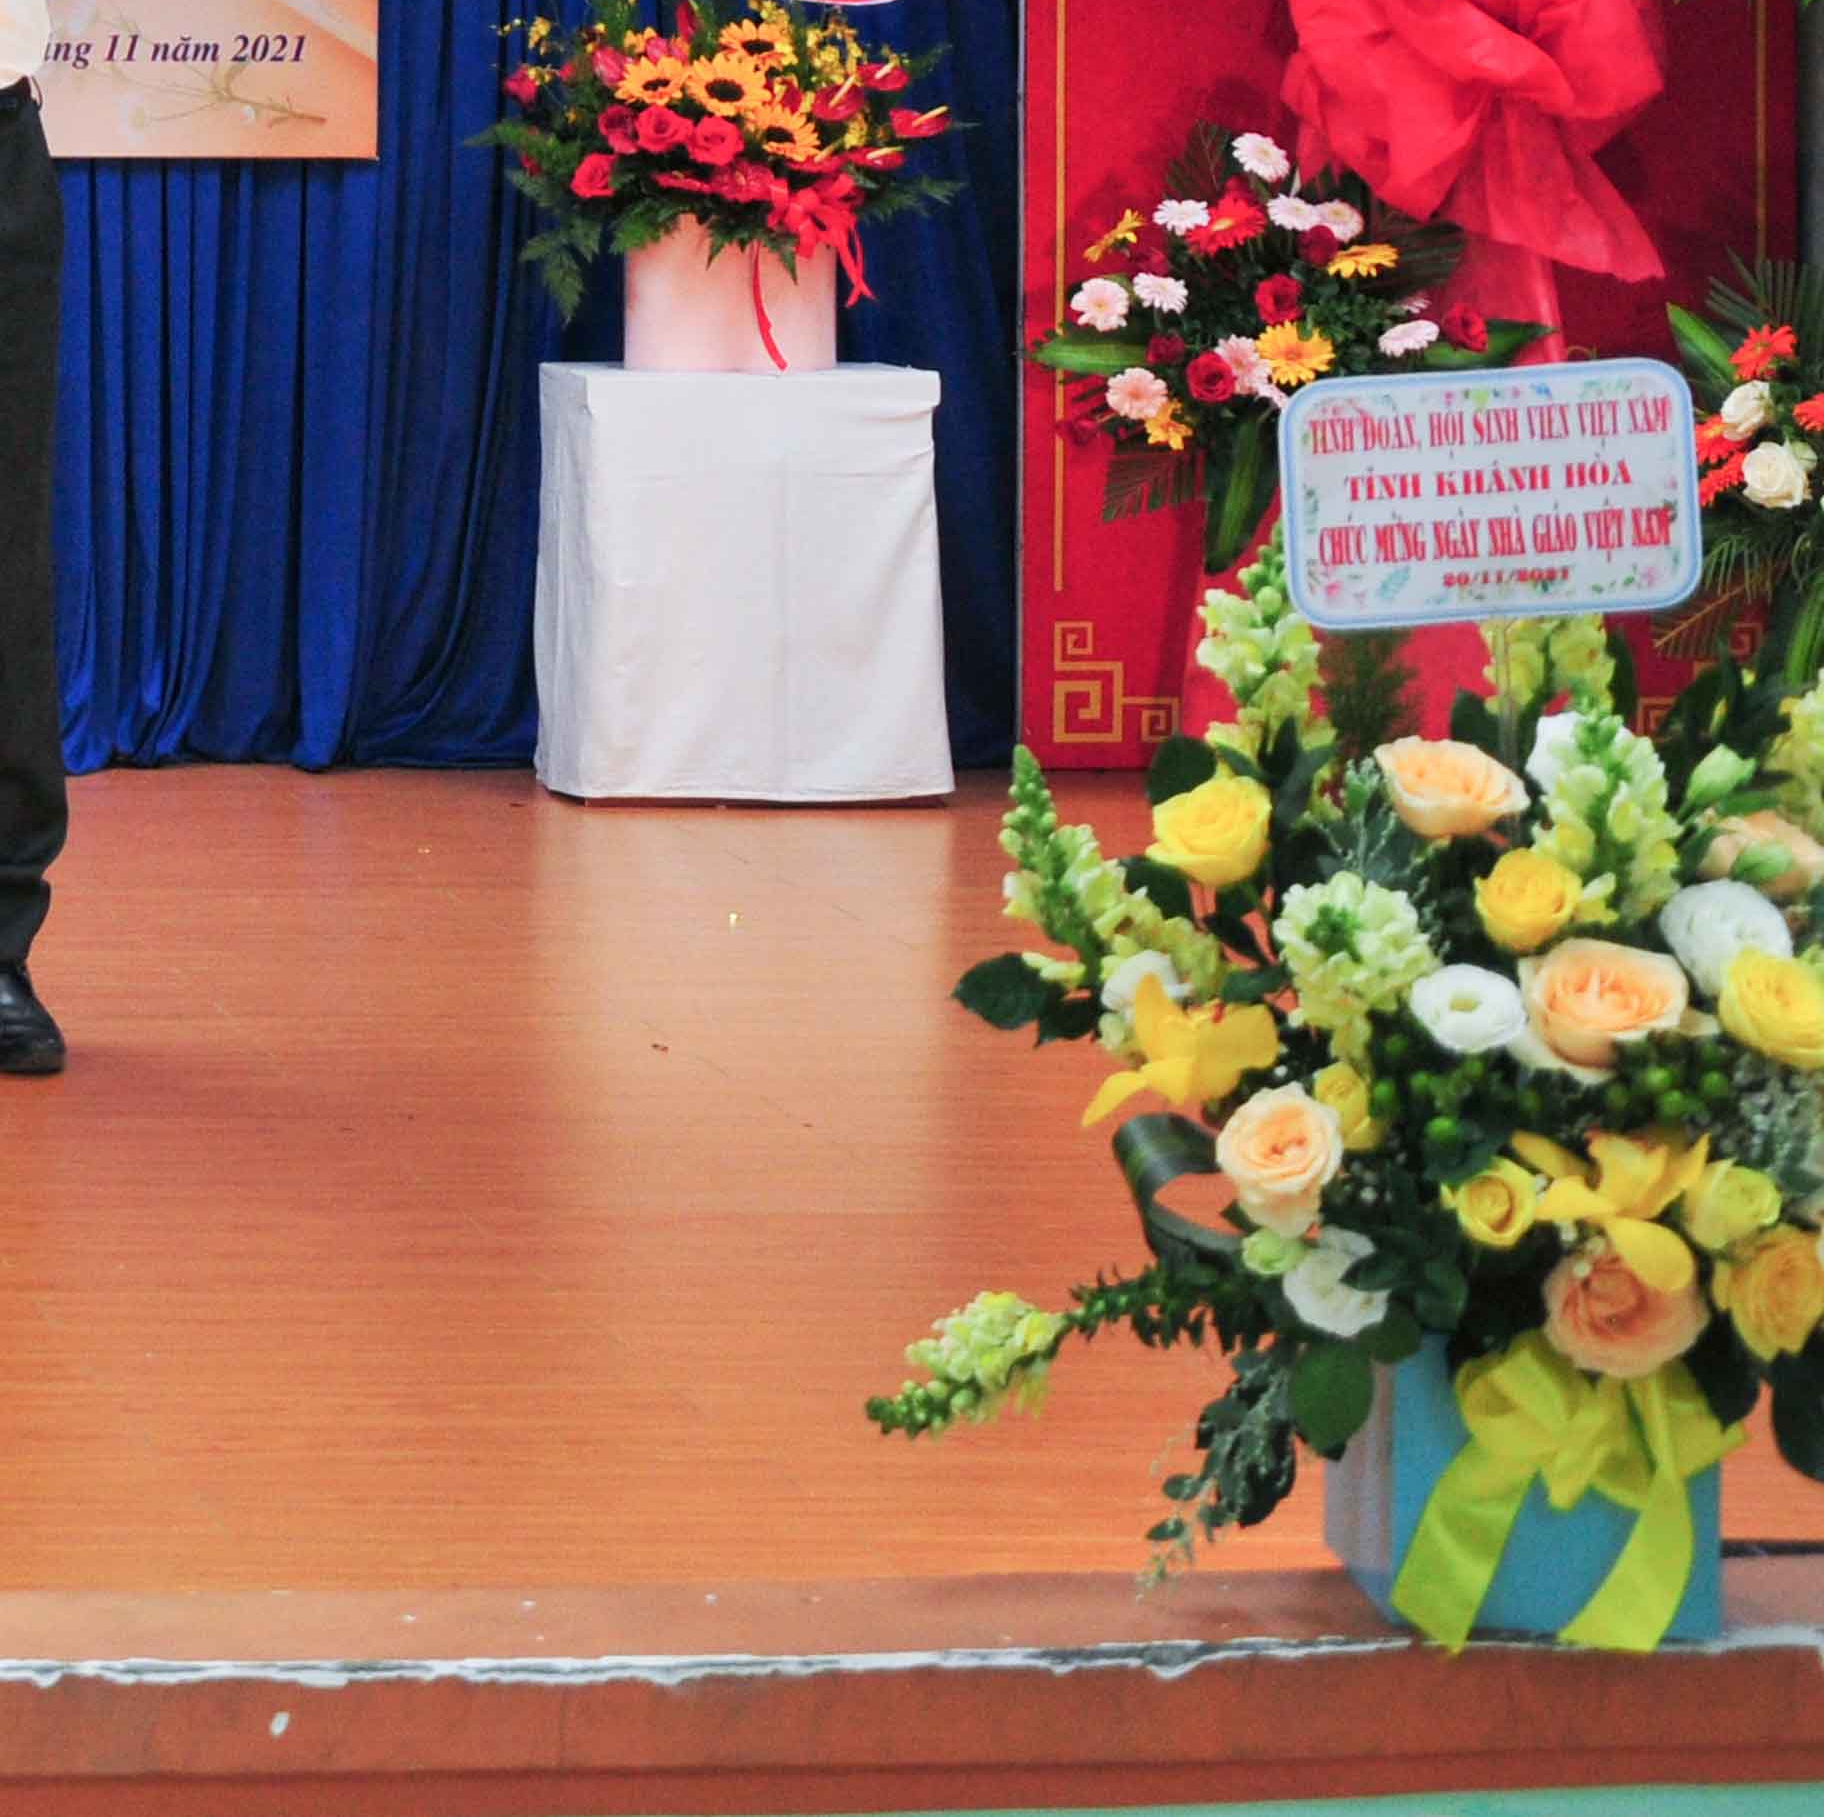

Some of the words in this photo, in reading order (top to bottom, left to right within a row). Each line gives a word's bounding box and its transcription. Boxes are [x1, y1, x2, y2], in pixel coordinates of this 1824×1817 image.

[103, 33, 140, 62] 11
[151, 36, 220, 62] năm
[230, 33, 306, 63] 2021
[1472, 406, 1520, 446] SINH
[1627, 393, 1672, 434] NAM
[1435, 459, 1550, 497] KHÁNH
[1565, 451, 1632, 489] HÒA
[1432, 506, 1480, 561] NGÀY
[1487, 504, 1526, 557] NHÀ
[1532, 498, 1578, 554] GIÁO
